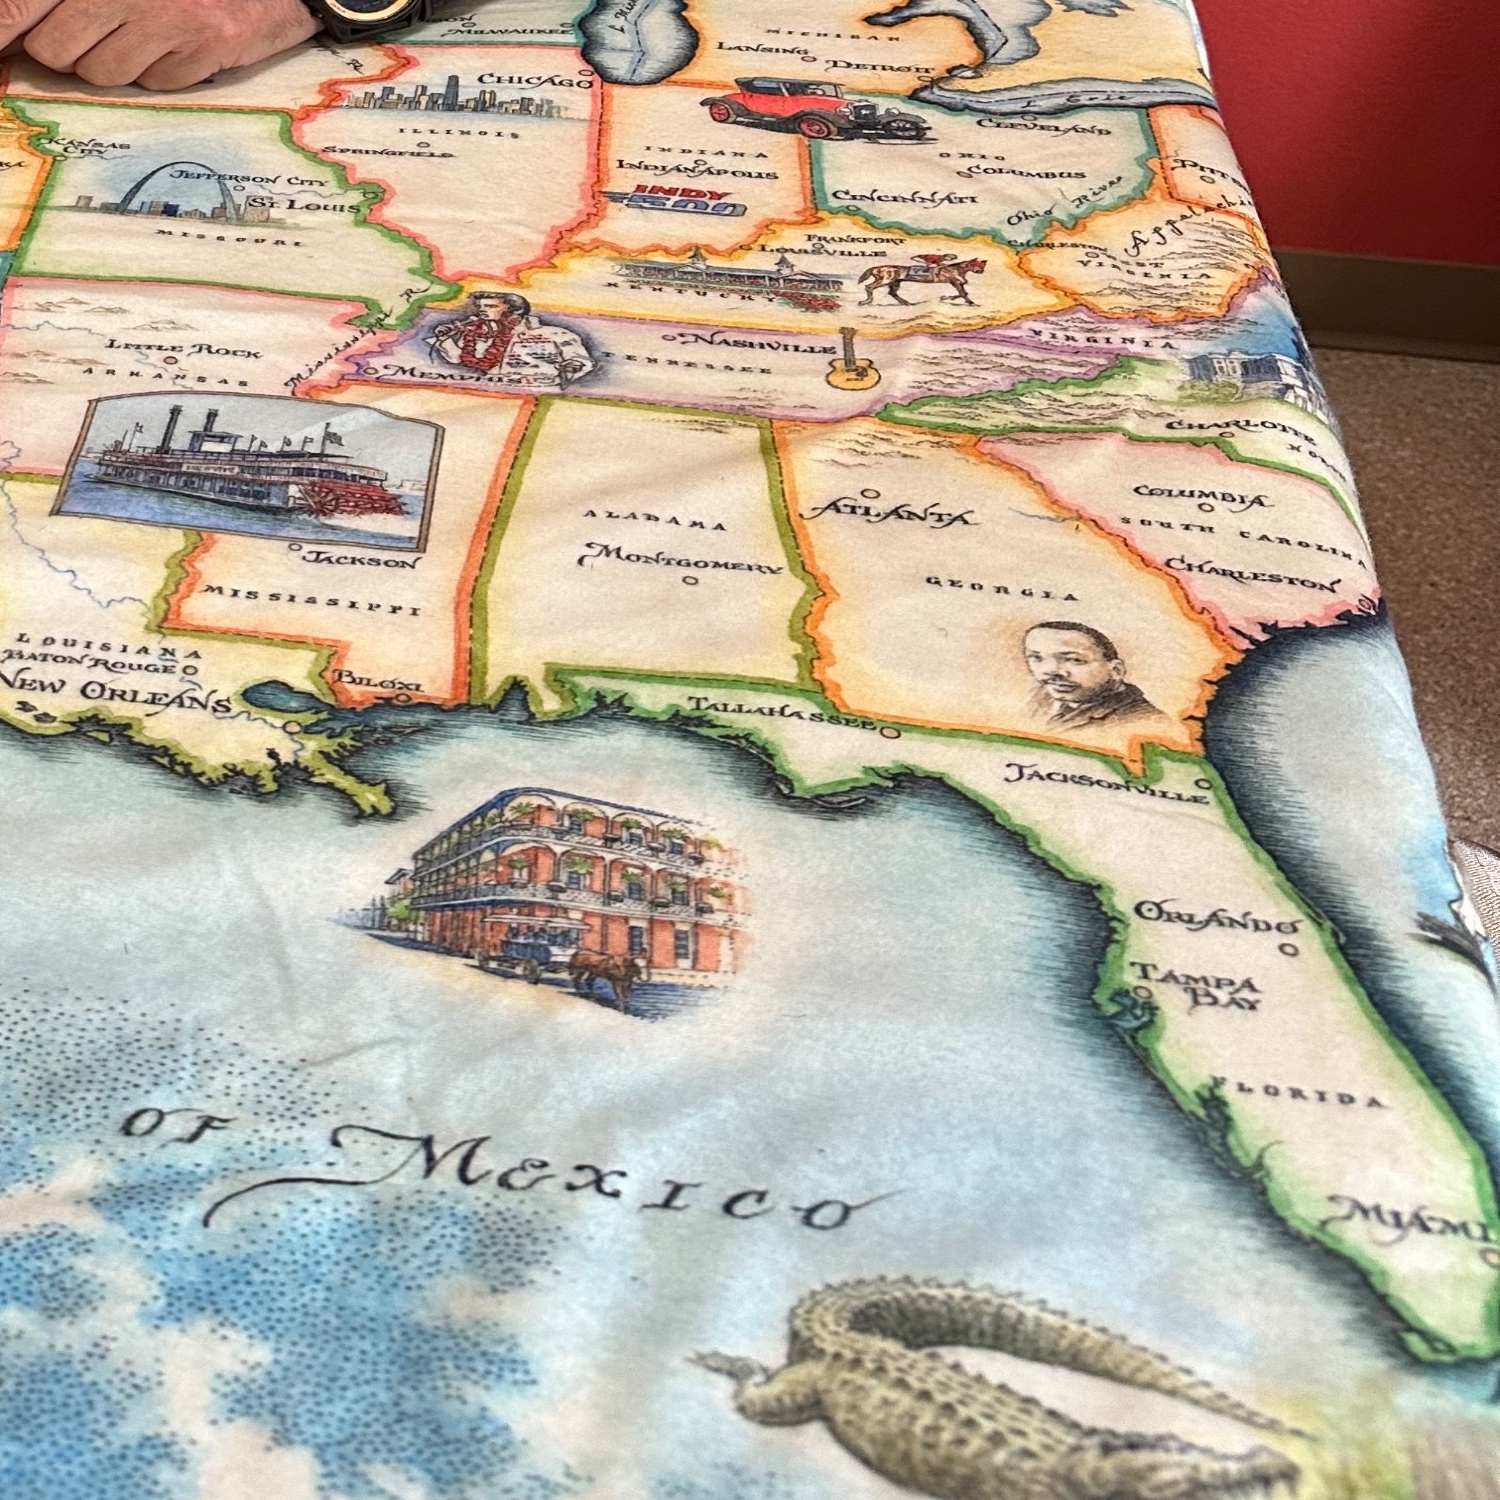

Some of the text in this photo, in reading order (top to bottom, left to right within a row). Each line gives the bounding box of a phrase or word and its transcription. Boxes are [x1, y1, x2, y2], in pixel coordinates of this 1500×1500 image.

[441, 23, 574, 38] MILWAUKEE
[764, 28, 900, 42] MICHIGAN
[715, 40, 809, 57] LANSING
[824, 58, 935, 75] DETROIT
[477, 70, 594, 90] CHICAGO
[399, 127, 520, 139] ILLINOIS
[975, 116, 1112, 138] CLEVELAND
[42, 136, 132, 150] KANSAS
[62, 144, 109, 156] CITY
[321, 144, 456, 159] SPRINGFIELD
[644, 145, 769, 159] INDIANA
[939, 151, 1006, 162] OHIO
[168, 168, 330, 188] JEFFERSON CITY
[615, 158, 780, 182] INDIANAPOLIS
[966, 163, 1087, 179] COLUMBUS
[632, 183, 734, 201] INDY
[830, 187, 980, 208] CINCINNATI
[1006, 175, 1124, 227] Ohio River
[287, 197, 362, 215] LOUIS
[624, 193, 747, 217] 500
[153, 228, 305, 248] MISSOURI
[758, 242, 888, 258] LOUISVILLE
[804, 233, 908, 247] FRANKFORT
[604, 280, 779, 304] KENTUCKY
[103, 337, 265, 361] LITTLE ROCK
[675, 329, 838, 356] NASHVILLE
[1028, 328, 1179, 350] VIRGINIA
[602, 350, 773, 375] TENNESSEE
[82, 366, 249, 388] ARKANSAS
[374, 364, 524, 386] MEMPHIS
[1164, 418, 1318, 447] CHARLOTTE
[1132, 482, 1276, 514] COLUMBIA
[582, 508, 728, 533] ALABAMA
[798, 495, 982, 529] ATLANTA
[1119, 514, 1370, 570] SOUTH CAROLINA
[301, 548, 423, 571] JACKSON
[575, 541, 784, 577] MONTGOMERY
[1164, 553, 1344, 595] CHARLESTON
[924, 574, 1081, 602] GEORGIA
[198, 583, 423, 619] MISSISSIPPI
[15, 631, 203, 660] LOUISIANA
[0, 646, 178, 677] BATON ROUGE
[330, 667, 426, 693] BILOXI
[79, 678, 236, 719] ORLEANS
[687, 694, 881, 733] TALLAHASSEE
[1002, 761, 1210, 806] JACKSONVILLE
[1132, 896, 1305, 936] ORLANDO
[1129, 960, 1264, 995] TAMPA
[1182, 983, 1263, 1016] BAY
[1209, 1072, 1389, 1110] FLORIDA
[1318, 1192, 1496, 1246] MIAMI
